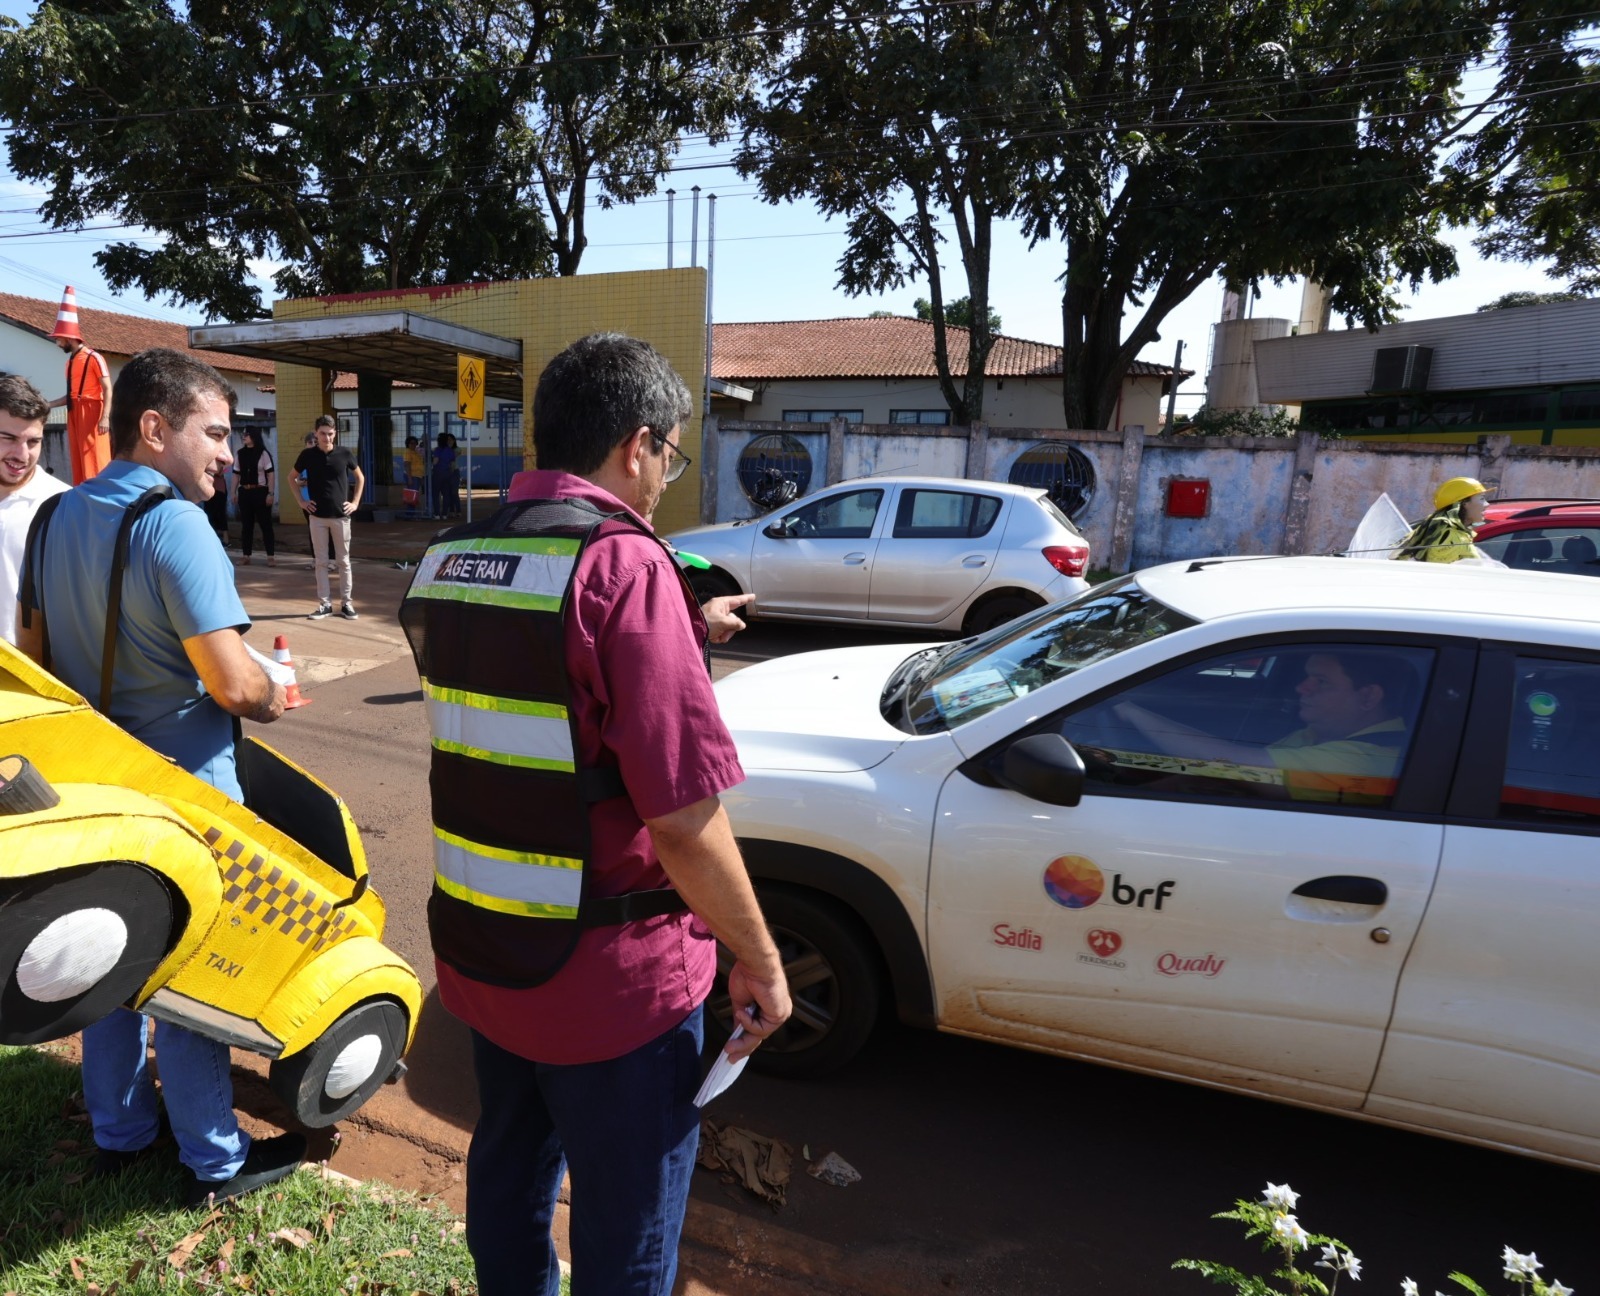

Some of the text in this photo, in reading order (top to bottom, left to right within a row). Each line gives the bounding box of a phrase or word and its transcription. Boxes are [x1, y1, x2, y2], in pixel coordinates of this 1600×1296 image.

[443, 559, 509, 580] AGETRAN
[1112, 874, 1175, 910] brf
[993, 924, 1042, 950] Sadia
[205, 952, 244, 978] TAXI
[1157, 953, 1224, 976] Qualy
